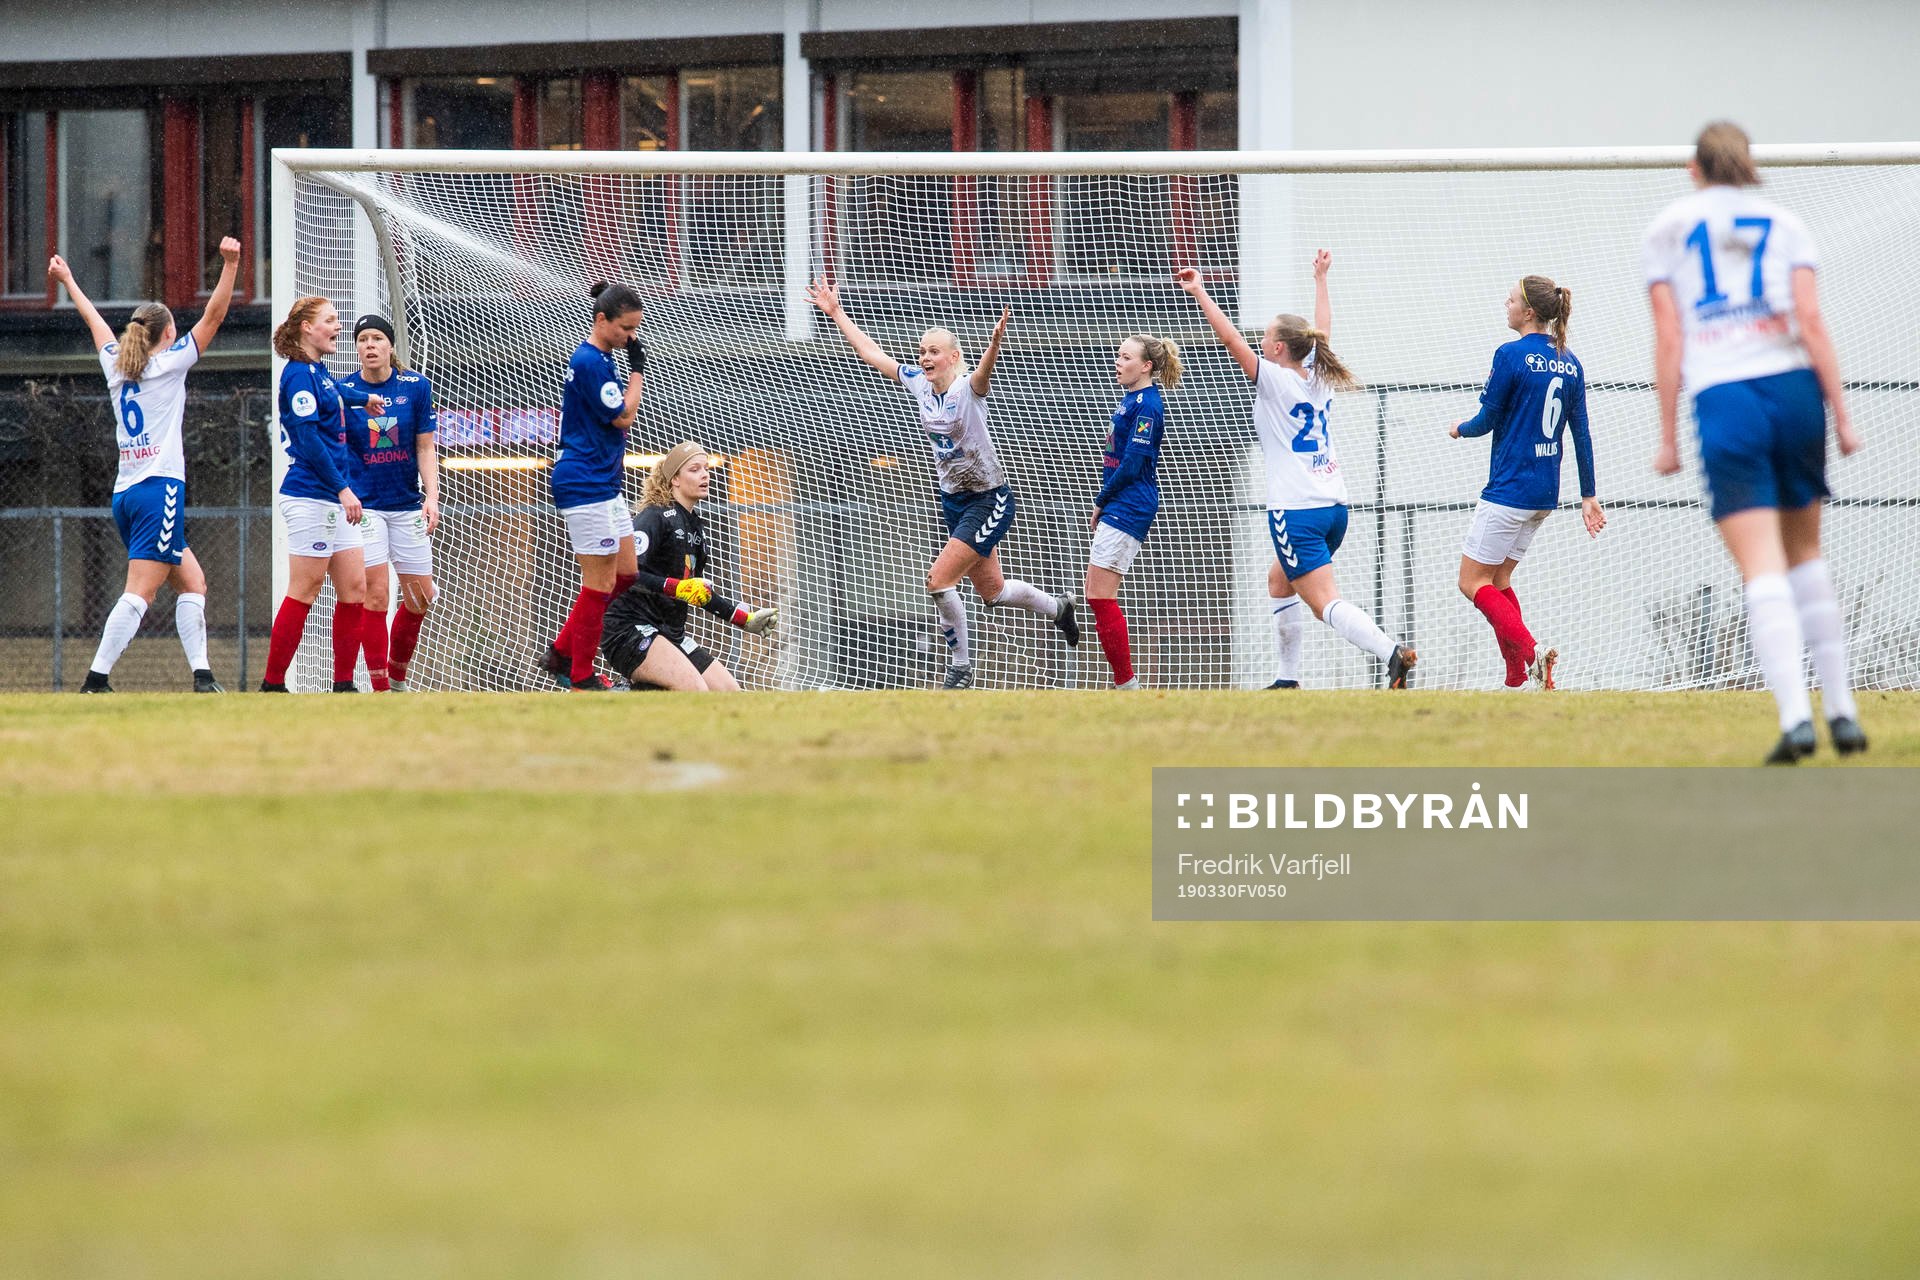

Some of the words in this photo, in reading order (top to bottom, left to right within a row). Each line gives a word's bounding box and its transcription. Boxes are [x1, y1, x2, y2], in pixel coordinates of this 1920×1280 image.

[1686, 217, 1771, 307] 17
[1549, 359, 1577, 377] OBOS
[120, 381, 144, 437] 6
[1542, 376, 1563, 439] 6
[136, 433, 150, 447] LIE
[133, 446, 160, 459] VALG
[363, 451, 409, 464] SABONA
